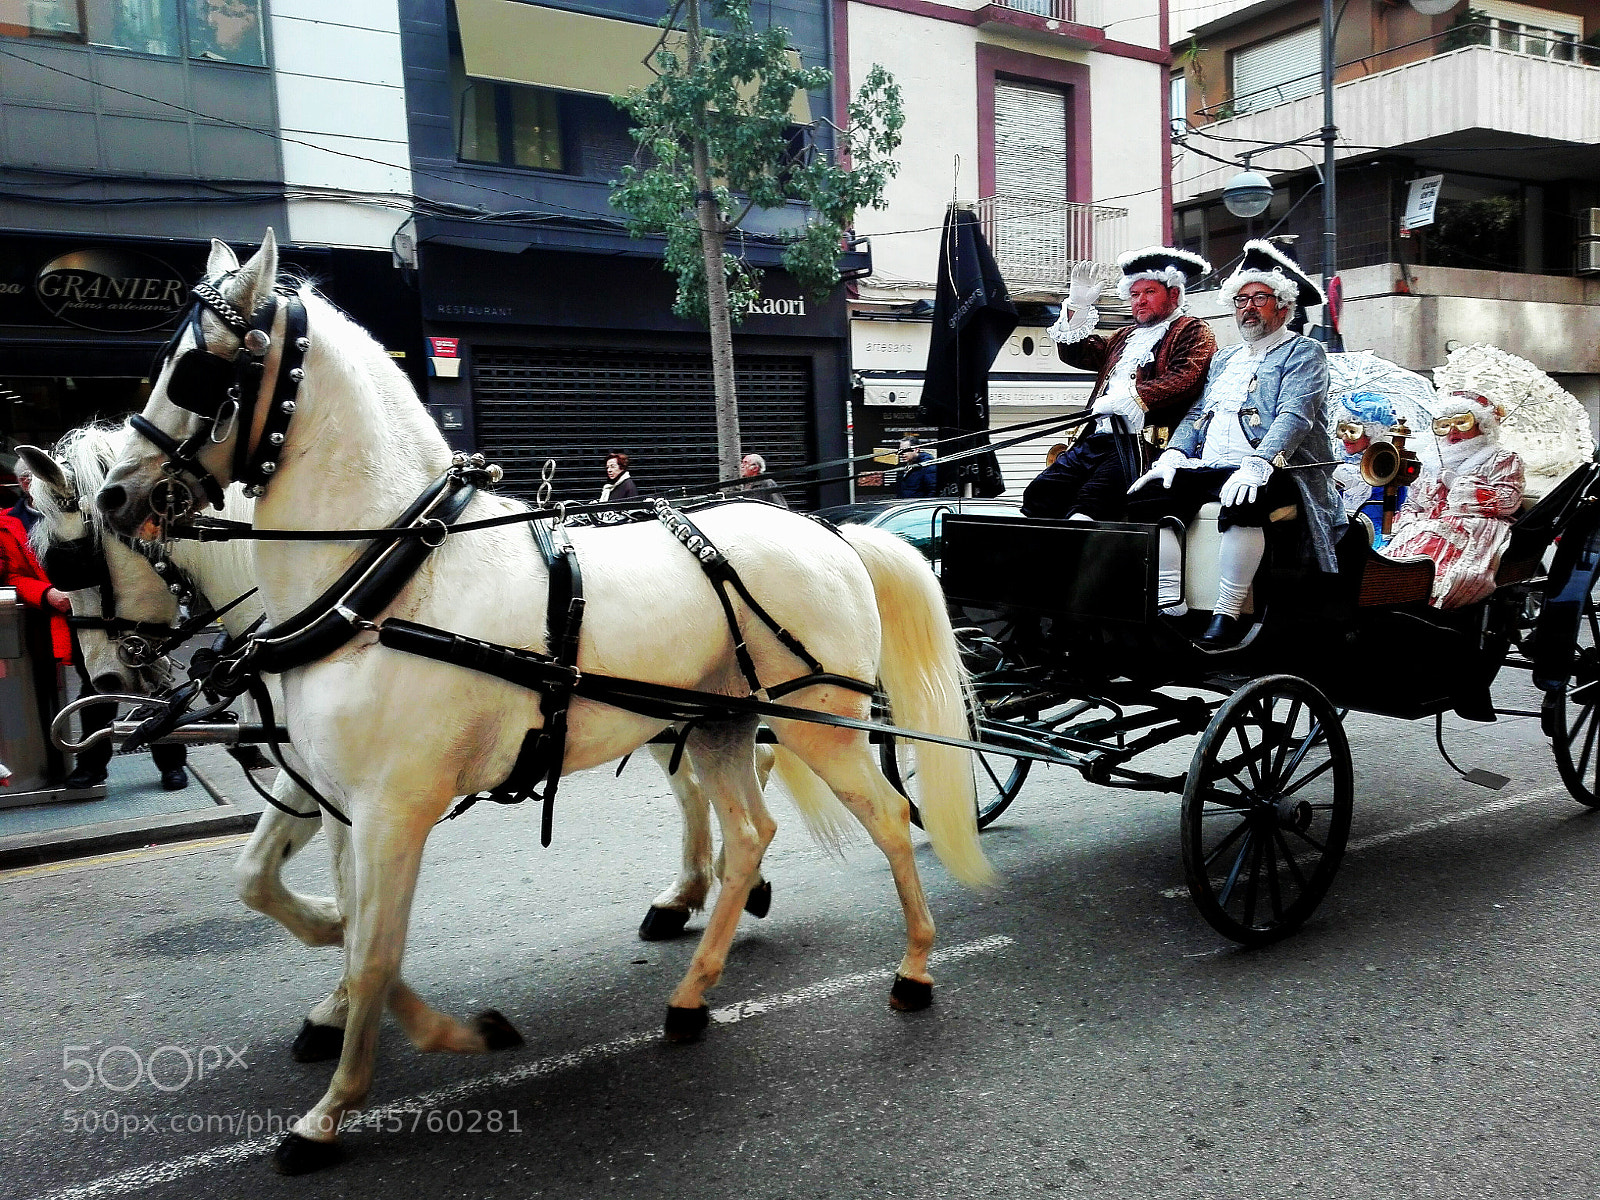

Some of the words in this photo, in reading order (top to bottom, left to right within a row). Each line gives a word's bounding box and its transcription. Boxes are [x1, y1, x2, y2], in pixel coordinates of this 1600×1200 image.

[39, 274, 187, 307] GRANIER
[107, 301, 172, 312] artesans
[437, 304, 513, 316] RESTAURANT
[865, 342, 913, 354] artesans
